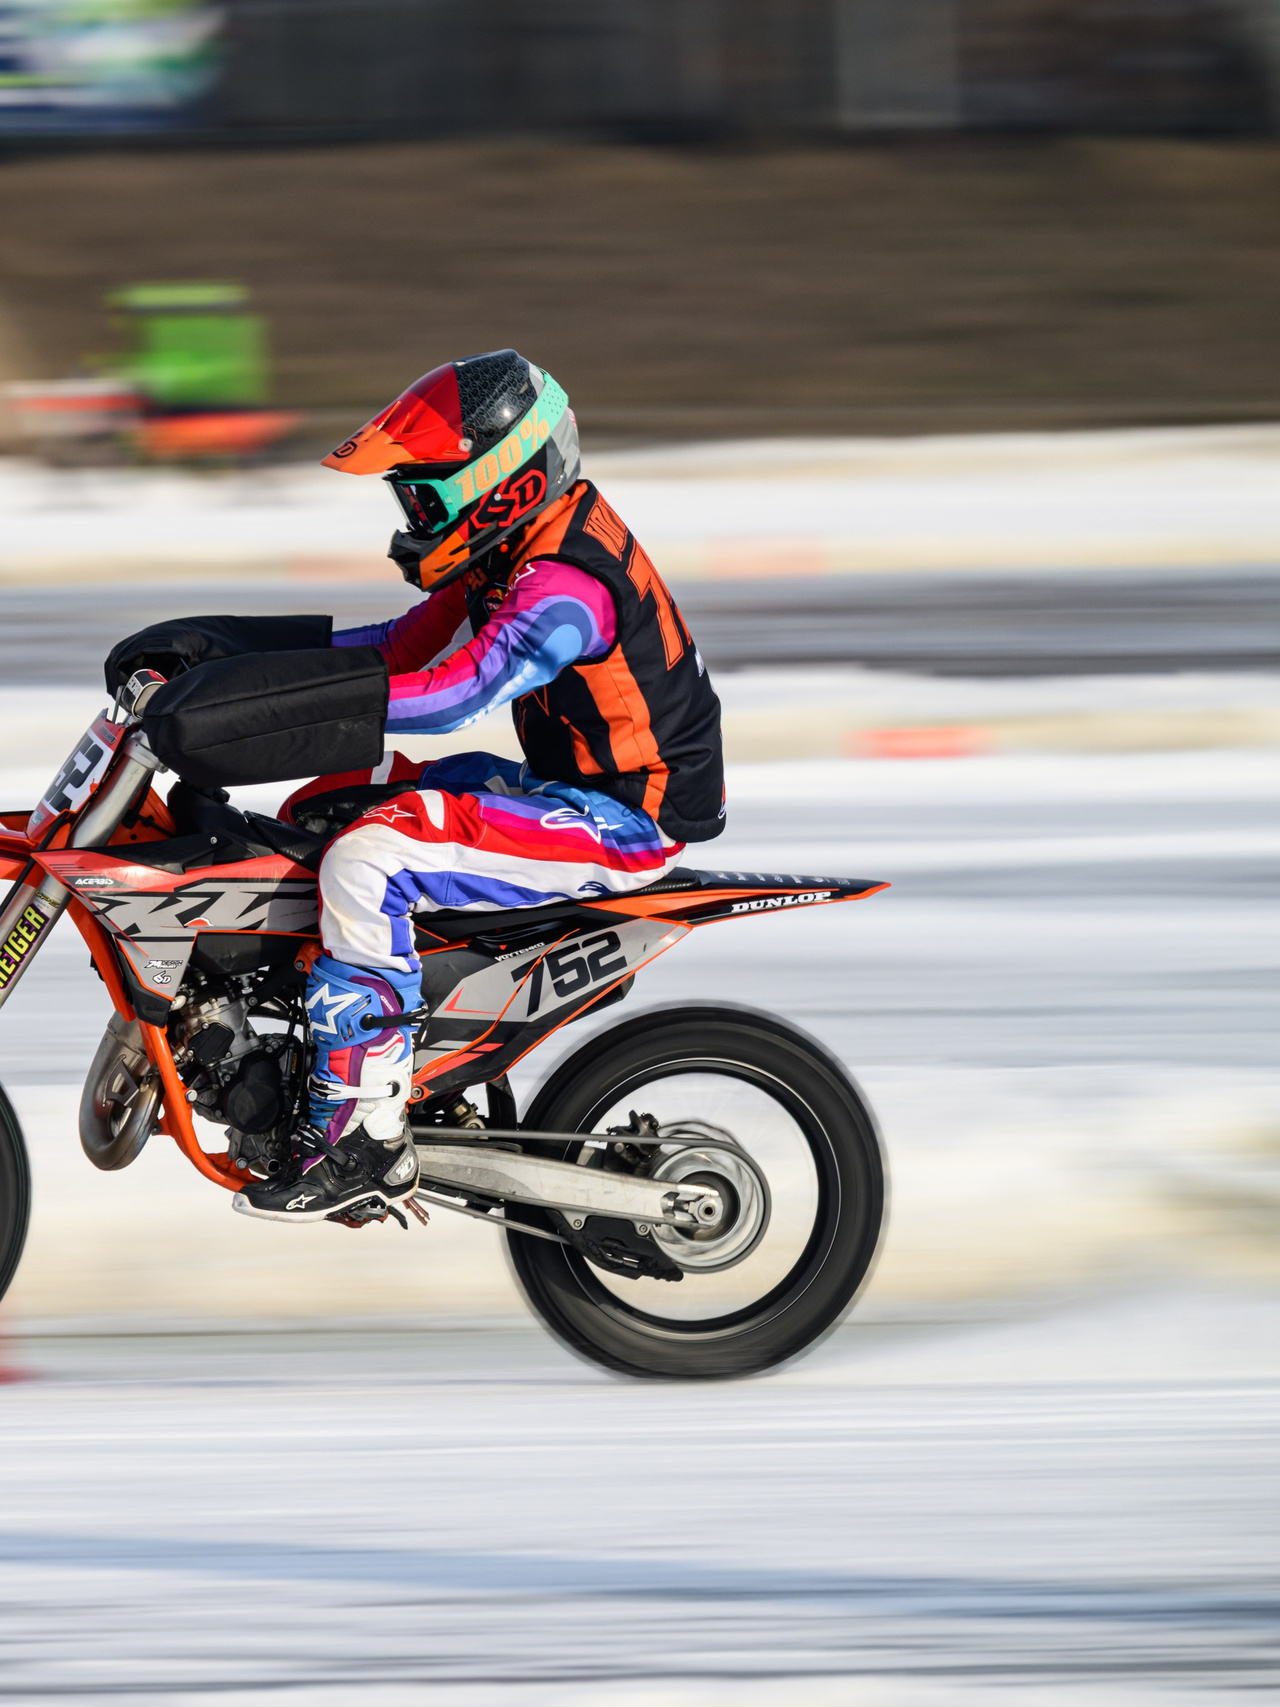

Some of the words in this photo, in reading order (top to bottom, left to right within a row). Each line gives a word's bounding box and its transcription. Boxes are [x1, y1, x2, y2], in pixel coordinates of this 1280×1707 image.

[454, 407, 549, 503] 100%
[731, 891, 831, 913] DUNLOP
[495, 942, 545, 962] VOYTENKO
[153, 971, 171, 984] 6D
[510, 931, 628, 1017] 752
